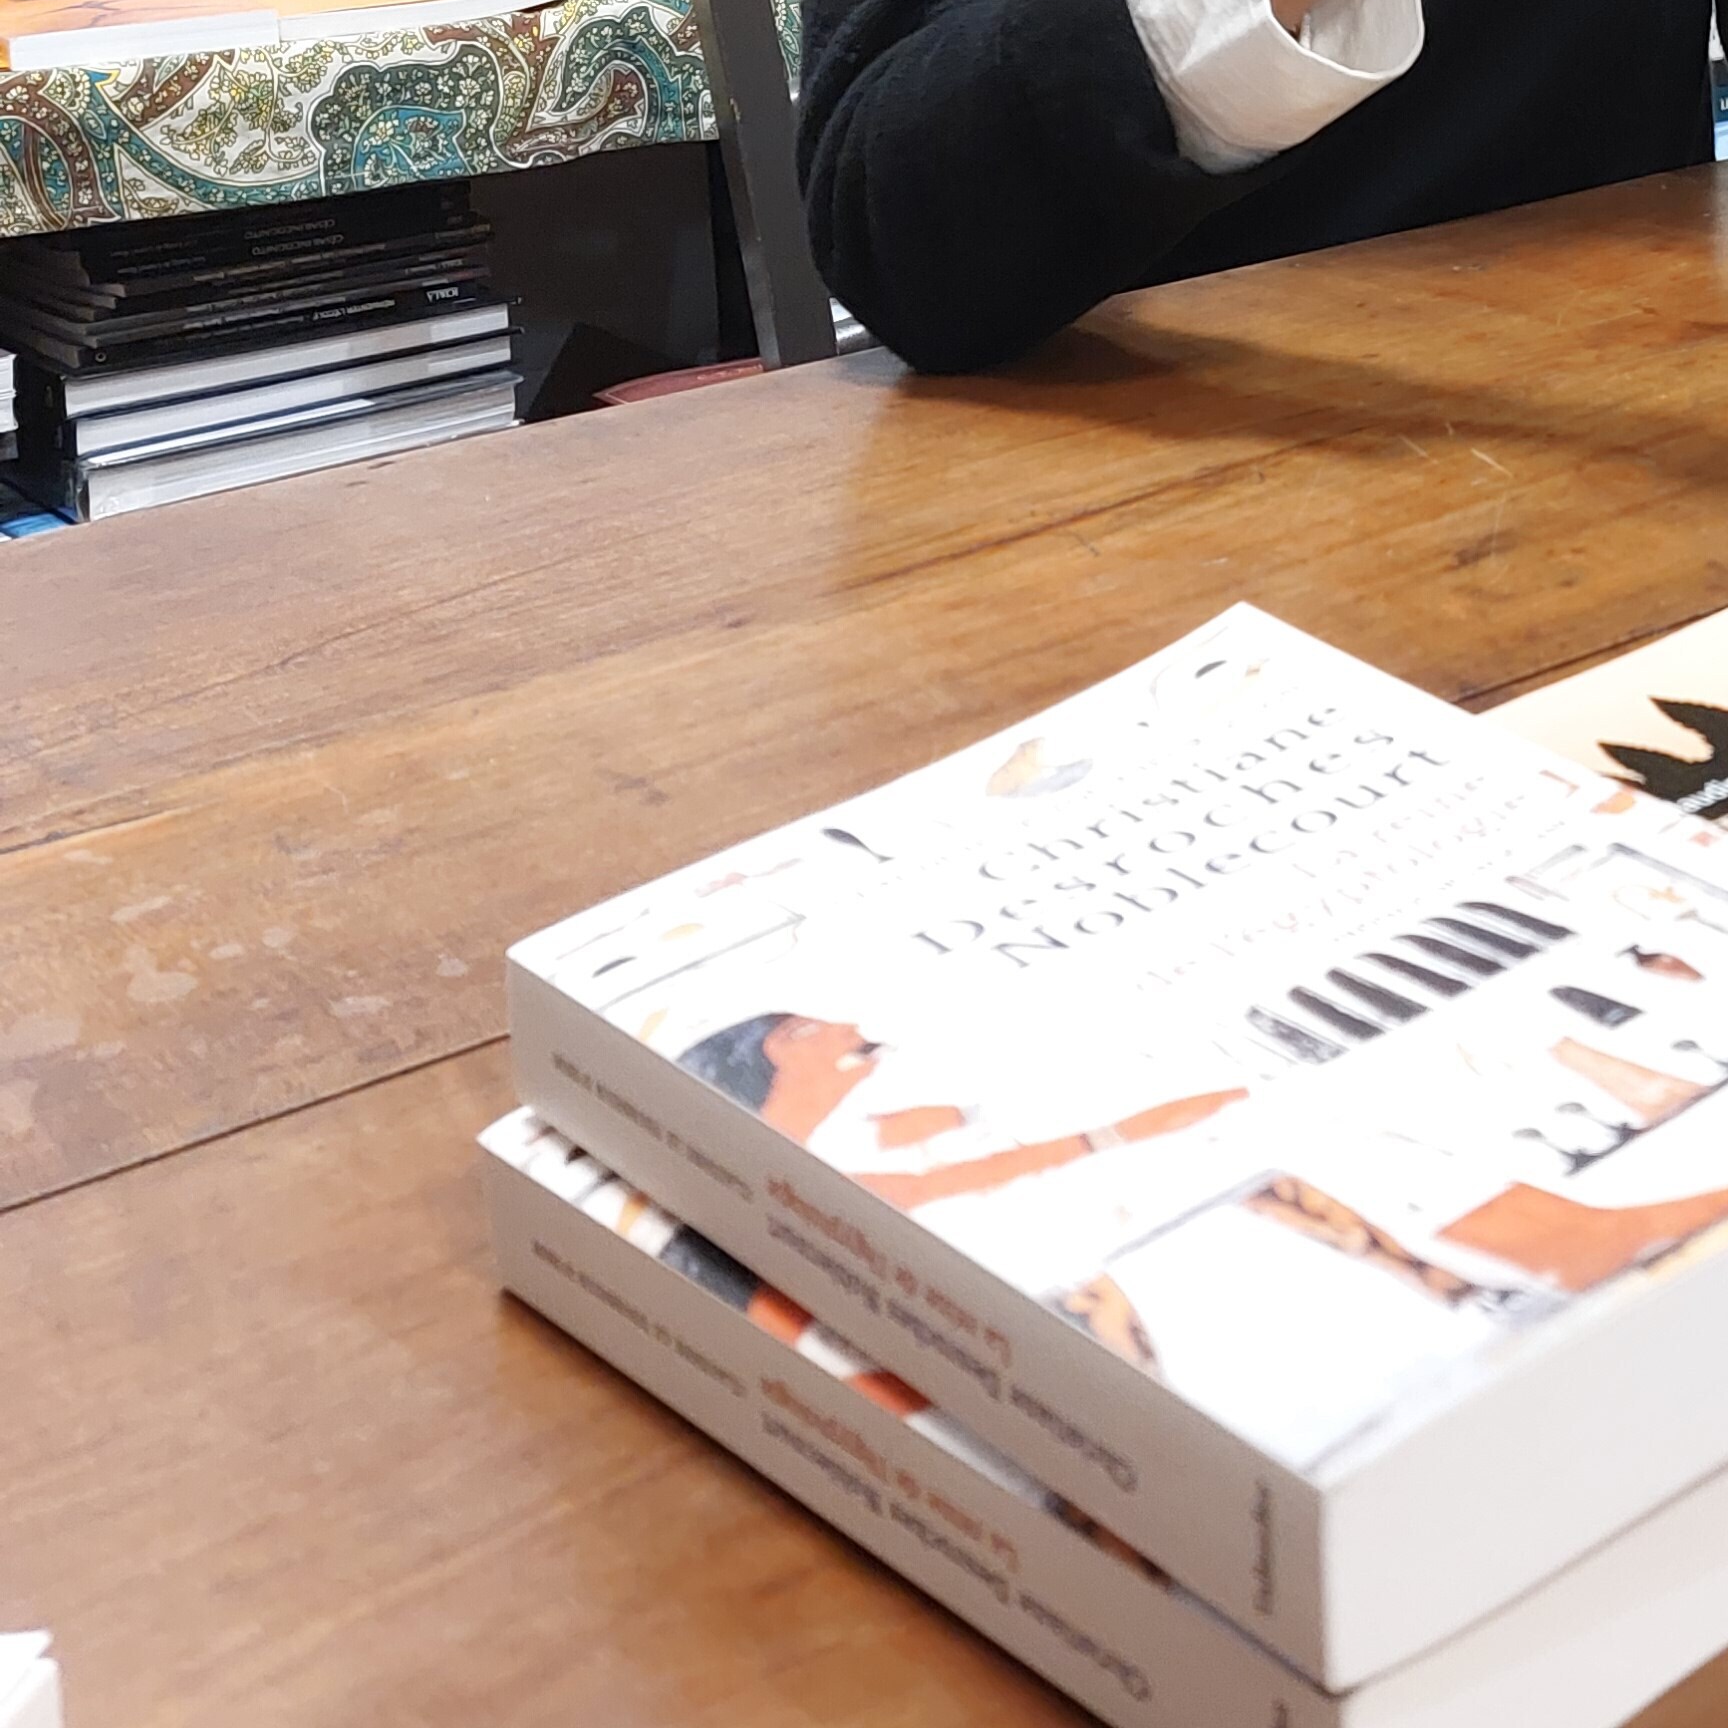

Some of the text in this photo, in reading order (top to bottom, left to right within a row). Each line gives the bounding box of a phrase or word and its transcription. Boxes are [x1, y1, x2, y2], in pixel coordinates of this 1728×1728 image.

[911, 730, 1396, 955] Desroches
[980, 703, 1351, 881] Christiane
[990, 746, 1450, 970] Noblecourt
